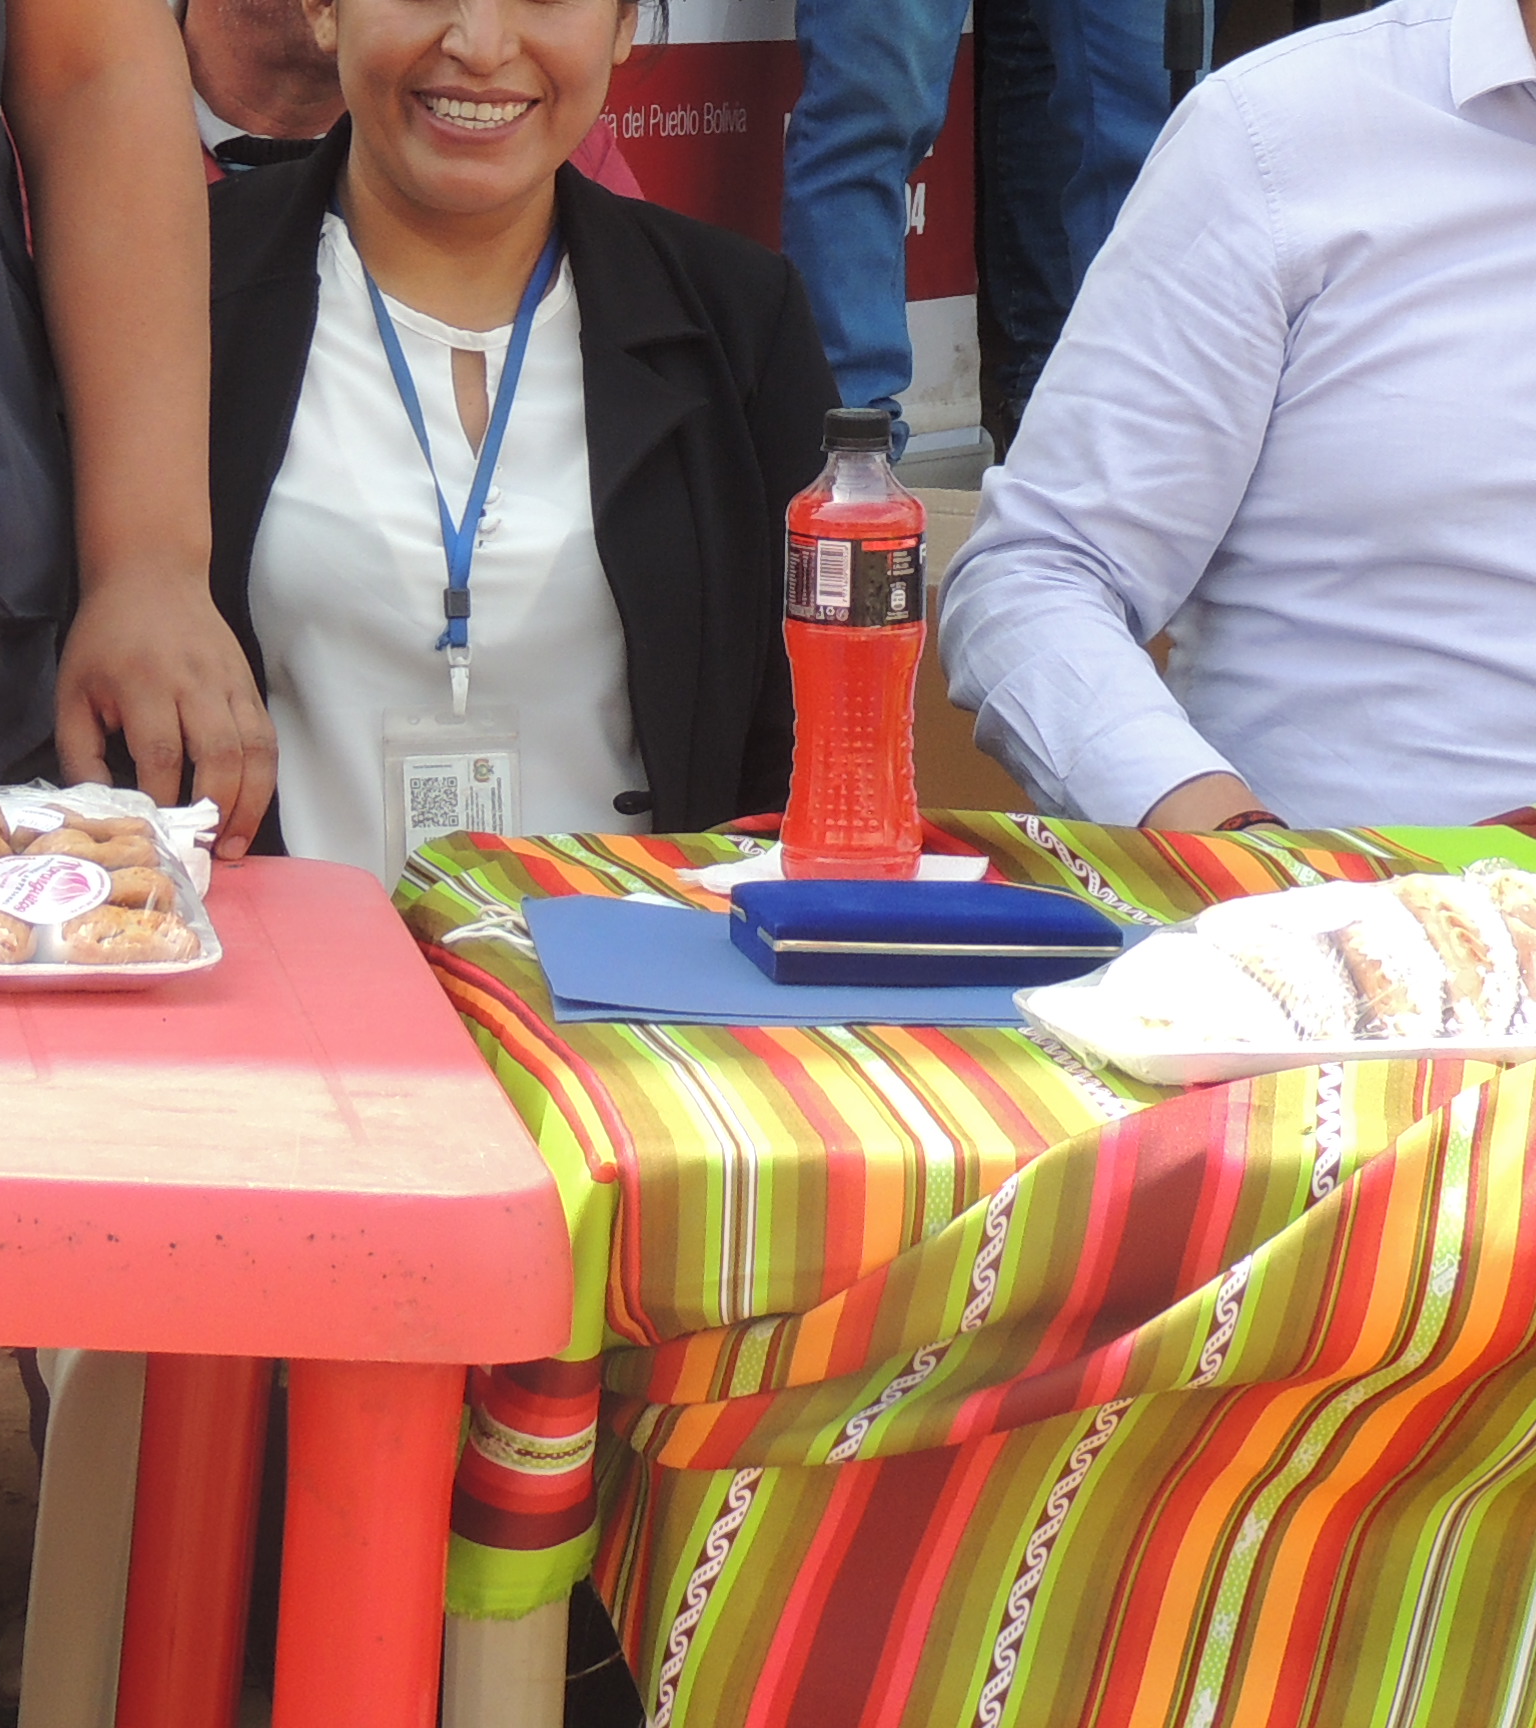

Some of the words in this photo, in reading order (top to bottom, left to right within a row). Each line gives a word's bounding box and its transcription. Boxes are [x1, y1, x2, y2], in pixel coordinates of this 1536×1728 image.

[622, 106, 645, 139] del
[649, 103, 699, 137] Pueblo
[703, 102, 747, 135] Bolivia
